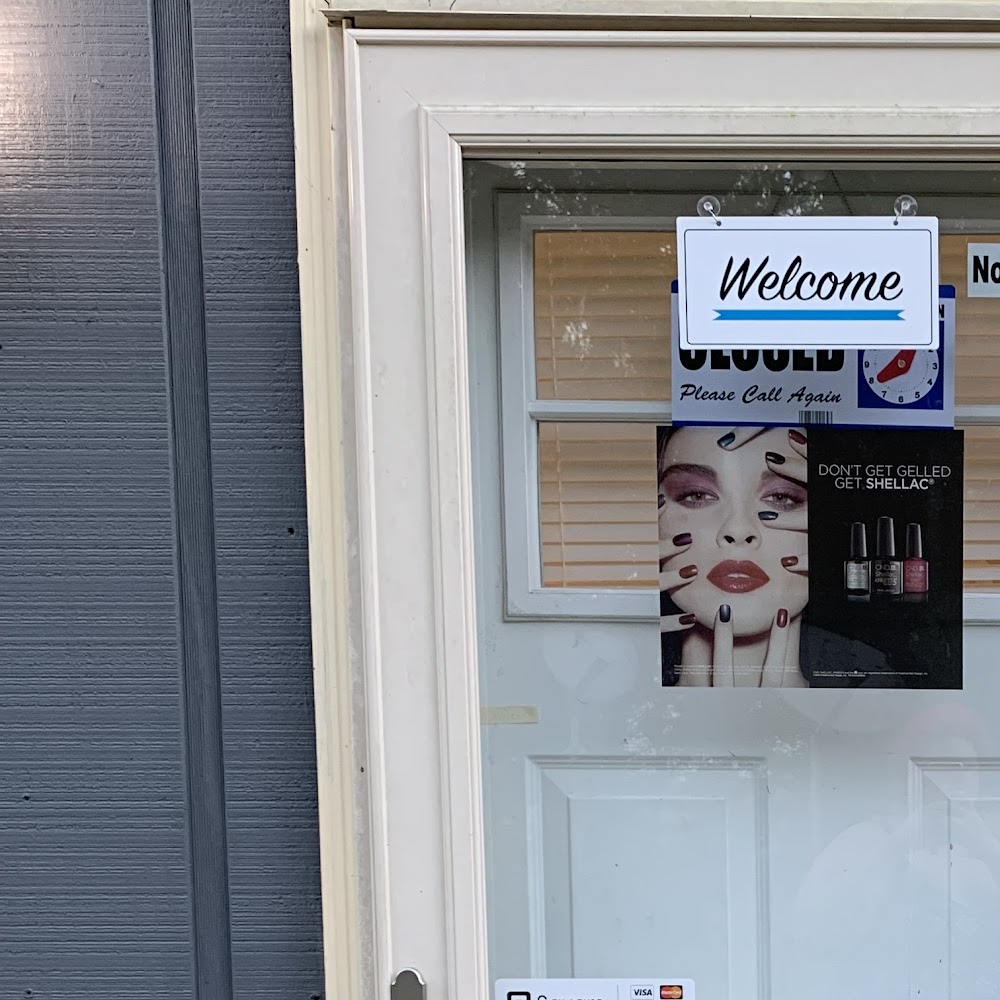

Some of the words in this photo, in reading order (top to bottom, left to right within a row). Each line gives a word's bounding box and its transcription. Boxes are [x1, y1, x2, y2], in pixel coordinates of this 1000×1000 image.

[719, 254, 904, 302] Welcome
[864, 360, 870, 369] 9
[932, 362, 938, 370] 3
[868, 376, 875, 385] 8
[926, 378, 933, 386] 4
[679, 383, 736, 402] Please
[741, 384, 783, 404] Call
[786, 385, 843, 408] Again
[881, 390, 887, 398] 7
[914, 391, 921, 399] 5
[898, 395, 904, 403] 6
[818, 463, 862, 476] DON'T
[865, 464, 894, 477] GET
[896, 465, 952, 478] GELLED
[834, 476, 863, 489] GET
[633, 988, 653, 996] VISA
